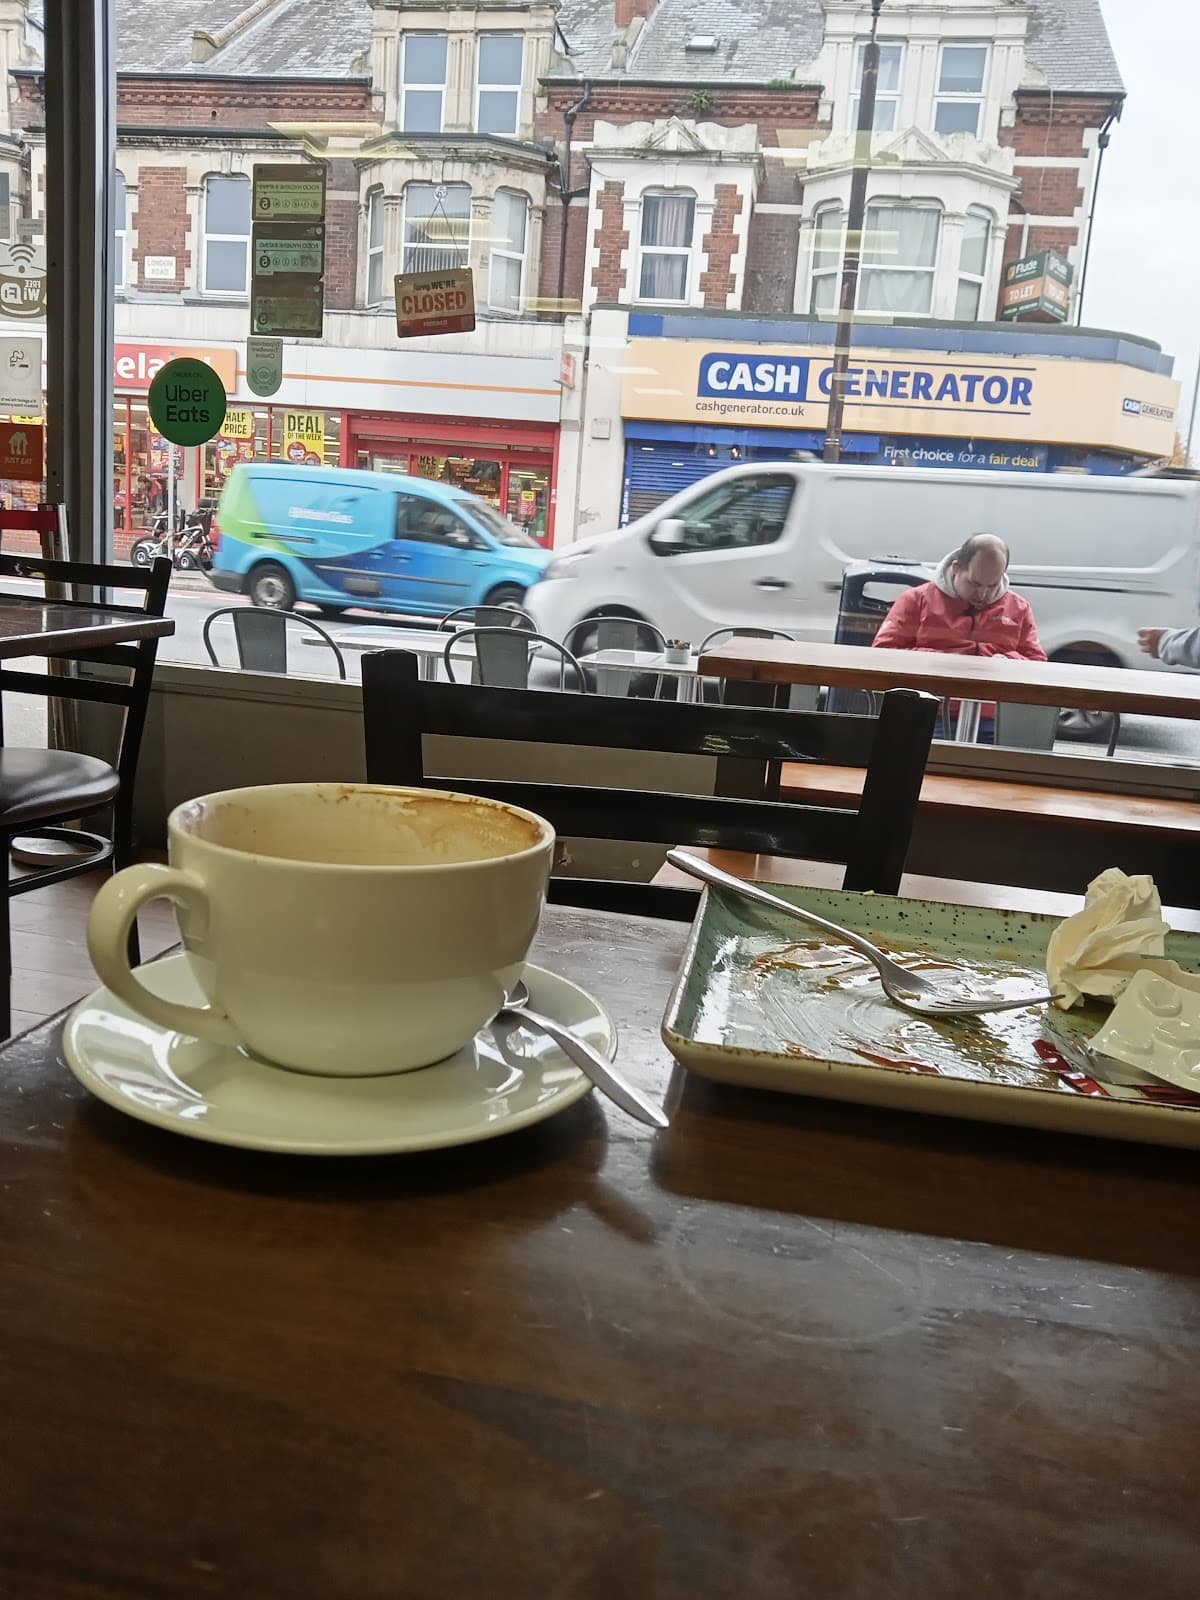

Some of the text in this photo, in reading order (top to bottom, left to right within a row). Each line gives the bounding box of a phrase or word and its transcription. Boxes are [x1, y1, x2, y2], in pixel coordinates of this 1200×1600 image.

[431, 279, 456, 290] WE'RE
[401, 291, 467, 314] CLOSED
[707, 360, 1033, 406] CASH GENERATOR
[165, 384, 209, 402] Uber
[166, 405, 210, 423] Eats
[226, 412, 246, 423] HALF
[695, 401, 805, 417] cashgenerator.co.uk
[224, 423, 247, 435] PRICE
[287, 414, 322, 433] DEAL
[306, 433, 322, 441] WEEK
[884, 446, 1039, 467] First choice for a fair deal
